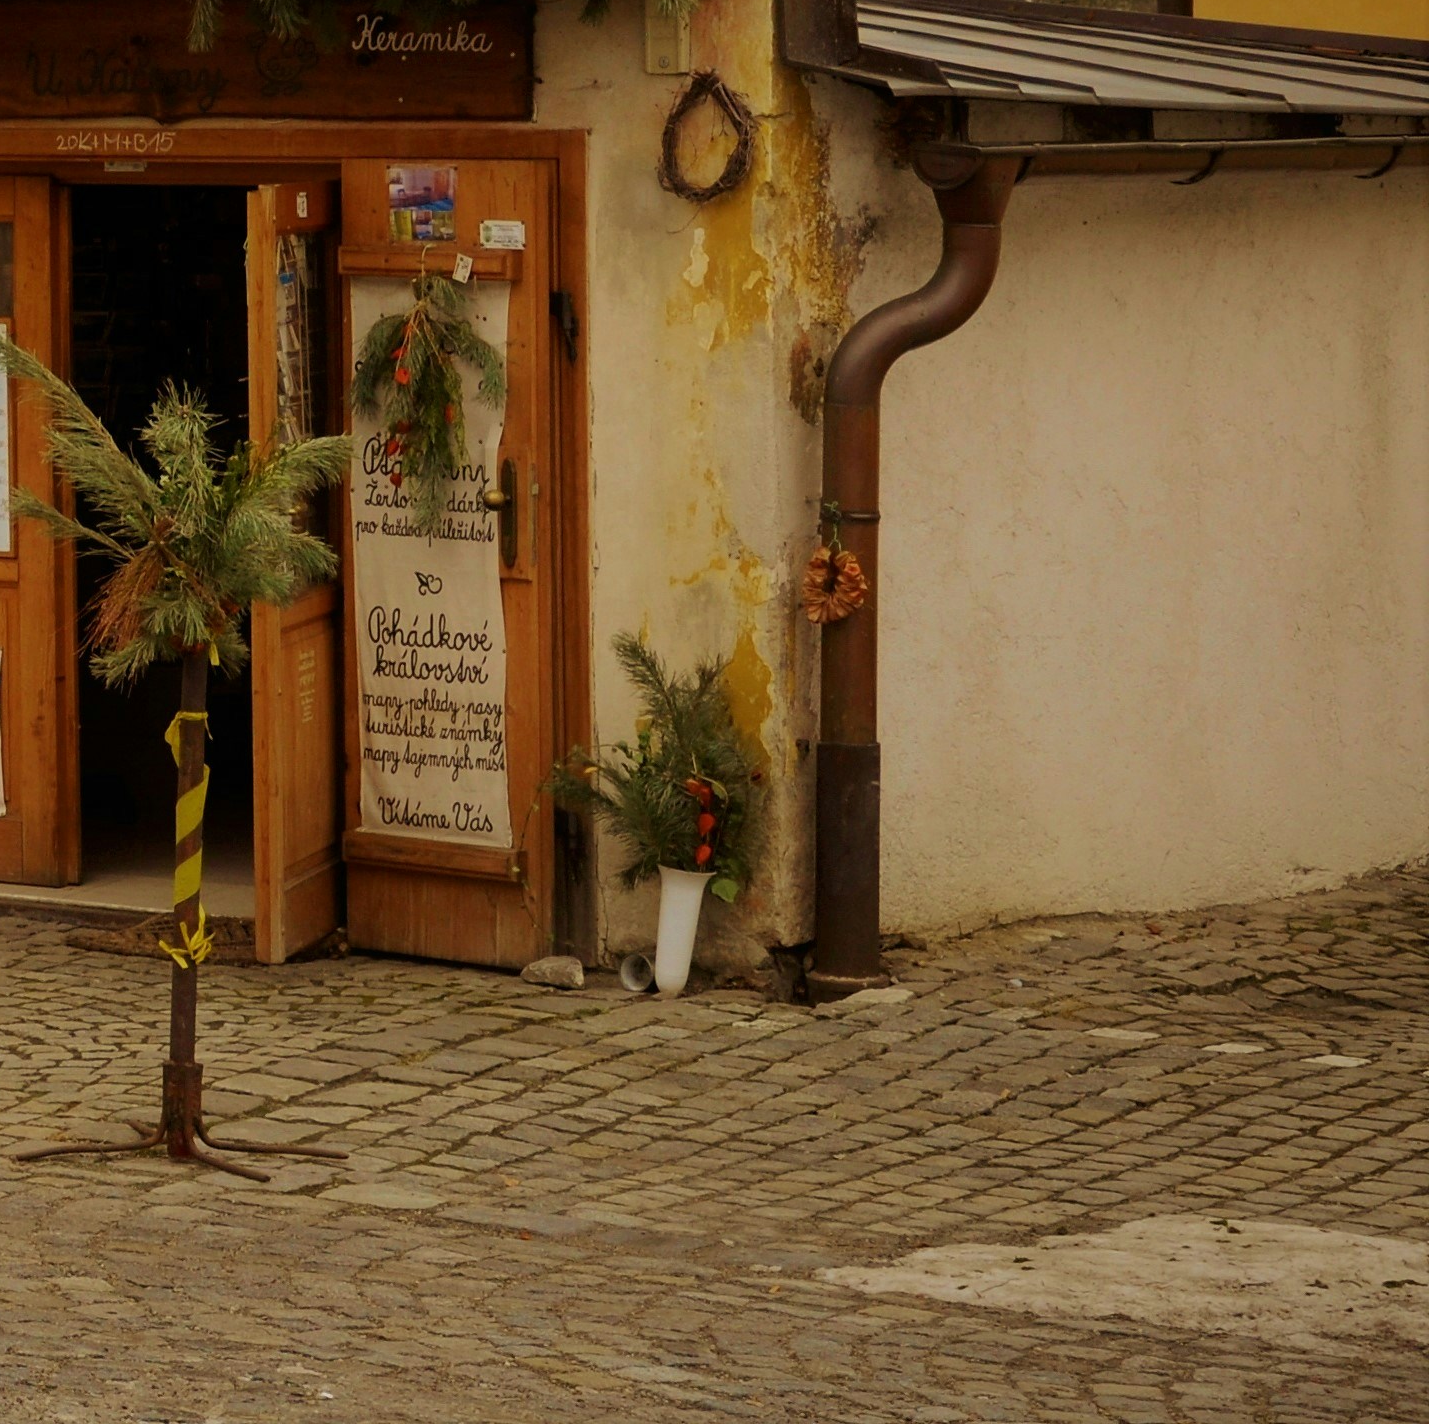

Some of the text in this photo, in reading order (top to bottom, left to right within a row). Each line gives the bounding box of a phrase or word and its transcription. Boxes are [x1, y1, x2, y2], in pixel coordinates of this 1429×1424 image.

[352, 14, 494, 55] Keramika
[355, 520, 387, 542] pro
[368, 605, 493, 651] Pohádkové
[372, 644, 488, 684] království
[362, 687, 503, 727] mapy pohledy pasy
[365, 709, 503, 756] turistické známky
[363, 747, 400, 774] mapy
[402, 740, 474, 782] tajemných
[377, 796, 493, 833] Vítáme Vás
